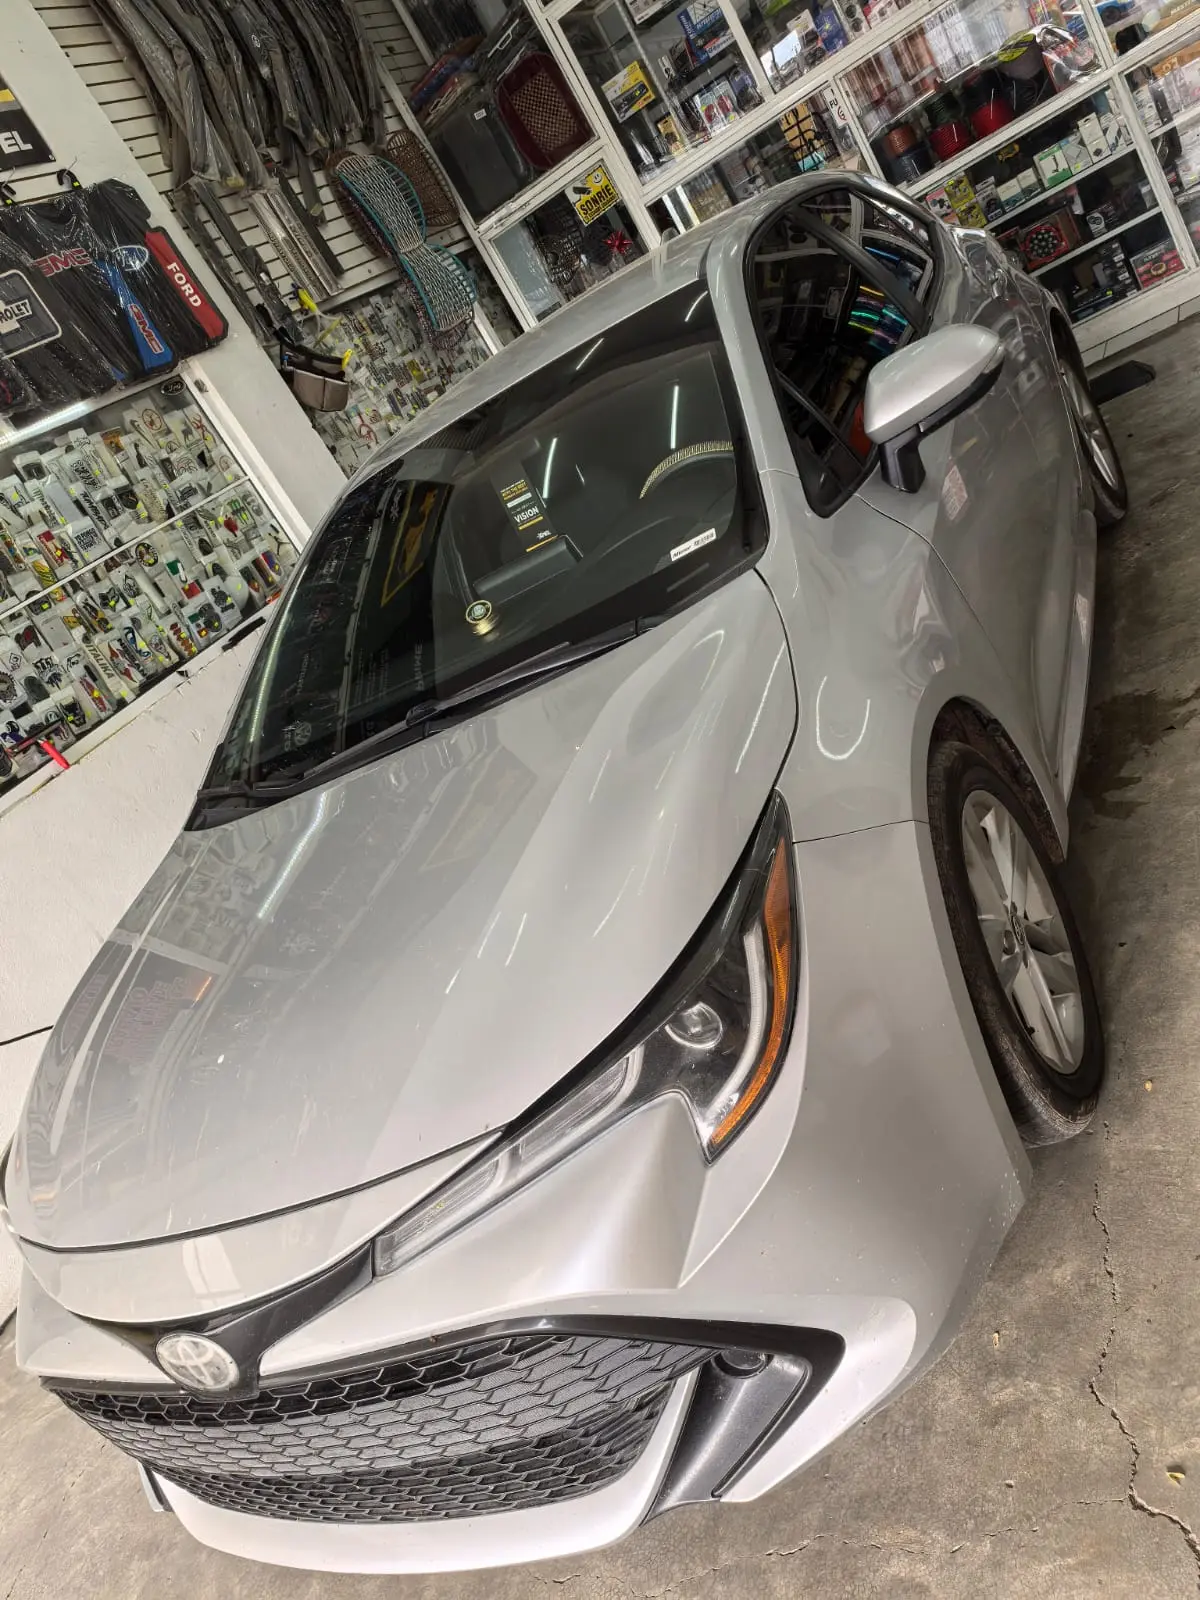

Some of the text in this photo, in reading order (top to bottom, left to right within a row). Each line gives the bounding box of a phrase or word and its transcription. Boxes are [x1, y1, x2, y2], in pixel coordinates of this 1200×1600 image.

[580, 184, 614, 216] SONRÍE
[167, 262, 202, 308] FORD
[129, 303, 165, 354] GMC
[514, 505, 540, 523] VISION
[85, 643, 115, 681] ITALIKA
